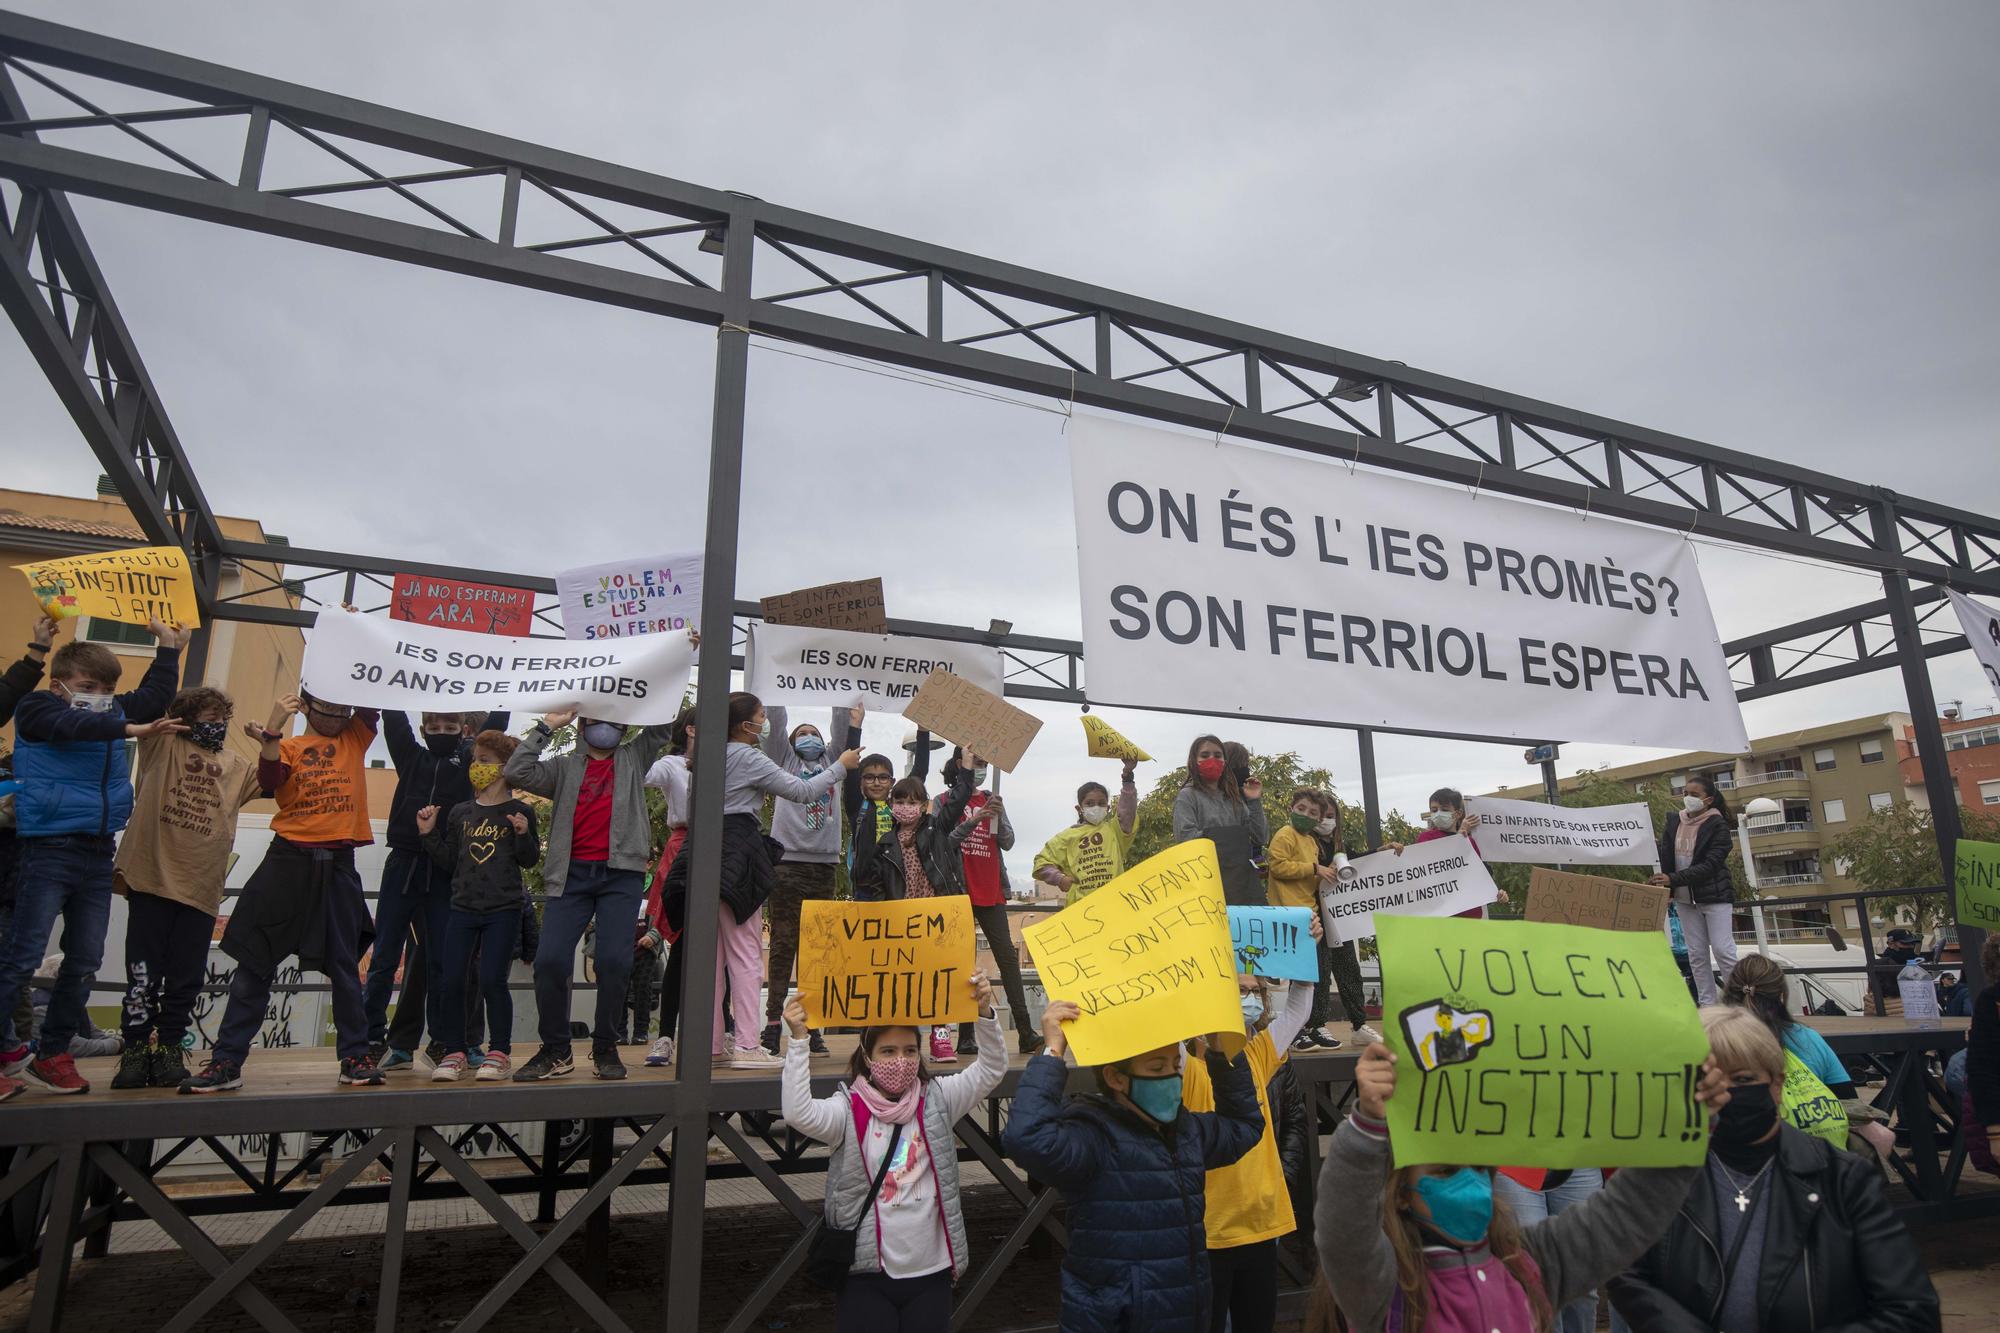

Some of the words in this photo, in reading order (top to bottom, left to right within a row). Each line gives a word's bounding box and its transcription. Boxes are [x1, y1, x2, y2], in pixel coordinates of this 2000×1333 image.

[1107, 481, 1197, 543] ON
[1220, 489, 1297, 558] ÉS
[1315, 516, 1349, 566] L'
[1367, 524, 1449, 581] IES
[1464, 541, 1681, 617] PROMÈS?
[402, 580, 421, 597] JA
[427, 584, 450, 598] NO
[599, 568, 672, 591] VOLEM
[583, 586, 665, 608] ESTUDIAR
[673, 584, 682, 595] A
[766, 593, 799, 611] ELS
[807, 584, 879, 604] INFANTS
[793, 607, 823, 621] SON
[828, 595, 884, 614] FERRIOL
[428, 603, 475, 624] ARA
[612, 600, 647, 617] L'IES
[585, 623, 620, 640] SON
[627, 617, 692, 636] FERRIOL
[1109, 585, 1246, 651] SON
[1268, 605, 1508, 681] FERRIOL
[1521, 637, 1711, 701] ESPERA
[395, 641, 437, 664] IES
[446, 652, 503, 671] SON
[512, 655, 622, 671] FERRIOL
[800, 649, 830, 665] IES
[836, 652, 876, 671] SON
[351, 663, 383, 683] 30
[388, 669, 465, 695] ANYS
[473, 681, 509, 694] DE
[518, 676, 648, 699] MENTIDES
[776, 674, 796, 689] 30
[802, 677, 851, 691] ANYS
[857, 679, 880, 694] DE
[184, 753, 222, 778] 30
[301, 743, 336, 767] 30
[184, 774, 215, 786] anys
[1481, 815, 1502, 825] ELS
[1505, 816, 1551, 828] INFANTS
[1553, 819, 1567, 830] DE
[1569, 823, 1589, 832] SON
[1593, 820, 1644, 832] FERRIOL
[1079, 832, 1104, 850] 30
[1083, 845, 1102, 856] anys
[1500, 833, 1572, 846] NECESSITAM
[1582, 837, 1630, 848] INSTITUT
[1388, 871, 1403, 885] DE
[1406, 865, 1427, 881] SON
[1428, 855, 1469, 876] FERRIOL
[1034, 905, 1104, 955] ELS
[1119, 855, 1214, 911] INFANTS
[1328, 893, 1404, 919] NECESSITAM
[1416, 880, 1459, 902] INSTITUT
[843, 912, 945, 941] VOLEM
[870, 946, 914, 967] UN
[1047, 953, 1102, 986] DE
[1109, 926, 1159, 964] SON
[1435, 948, 1648, 1000] VOLEM
[823, 967, 957, 1020] INSTITUT
[1515, 1023, 1592, 1060] UN
